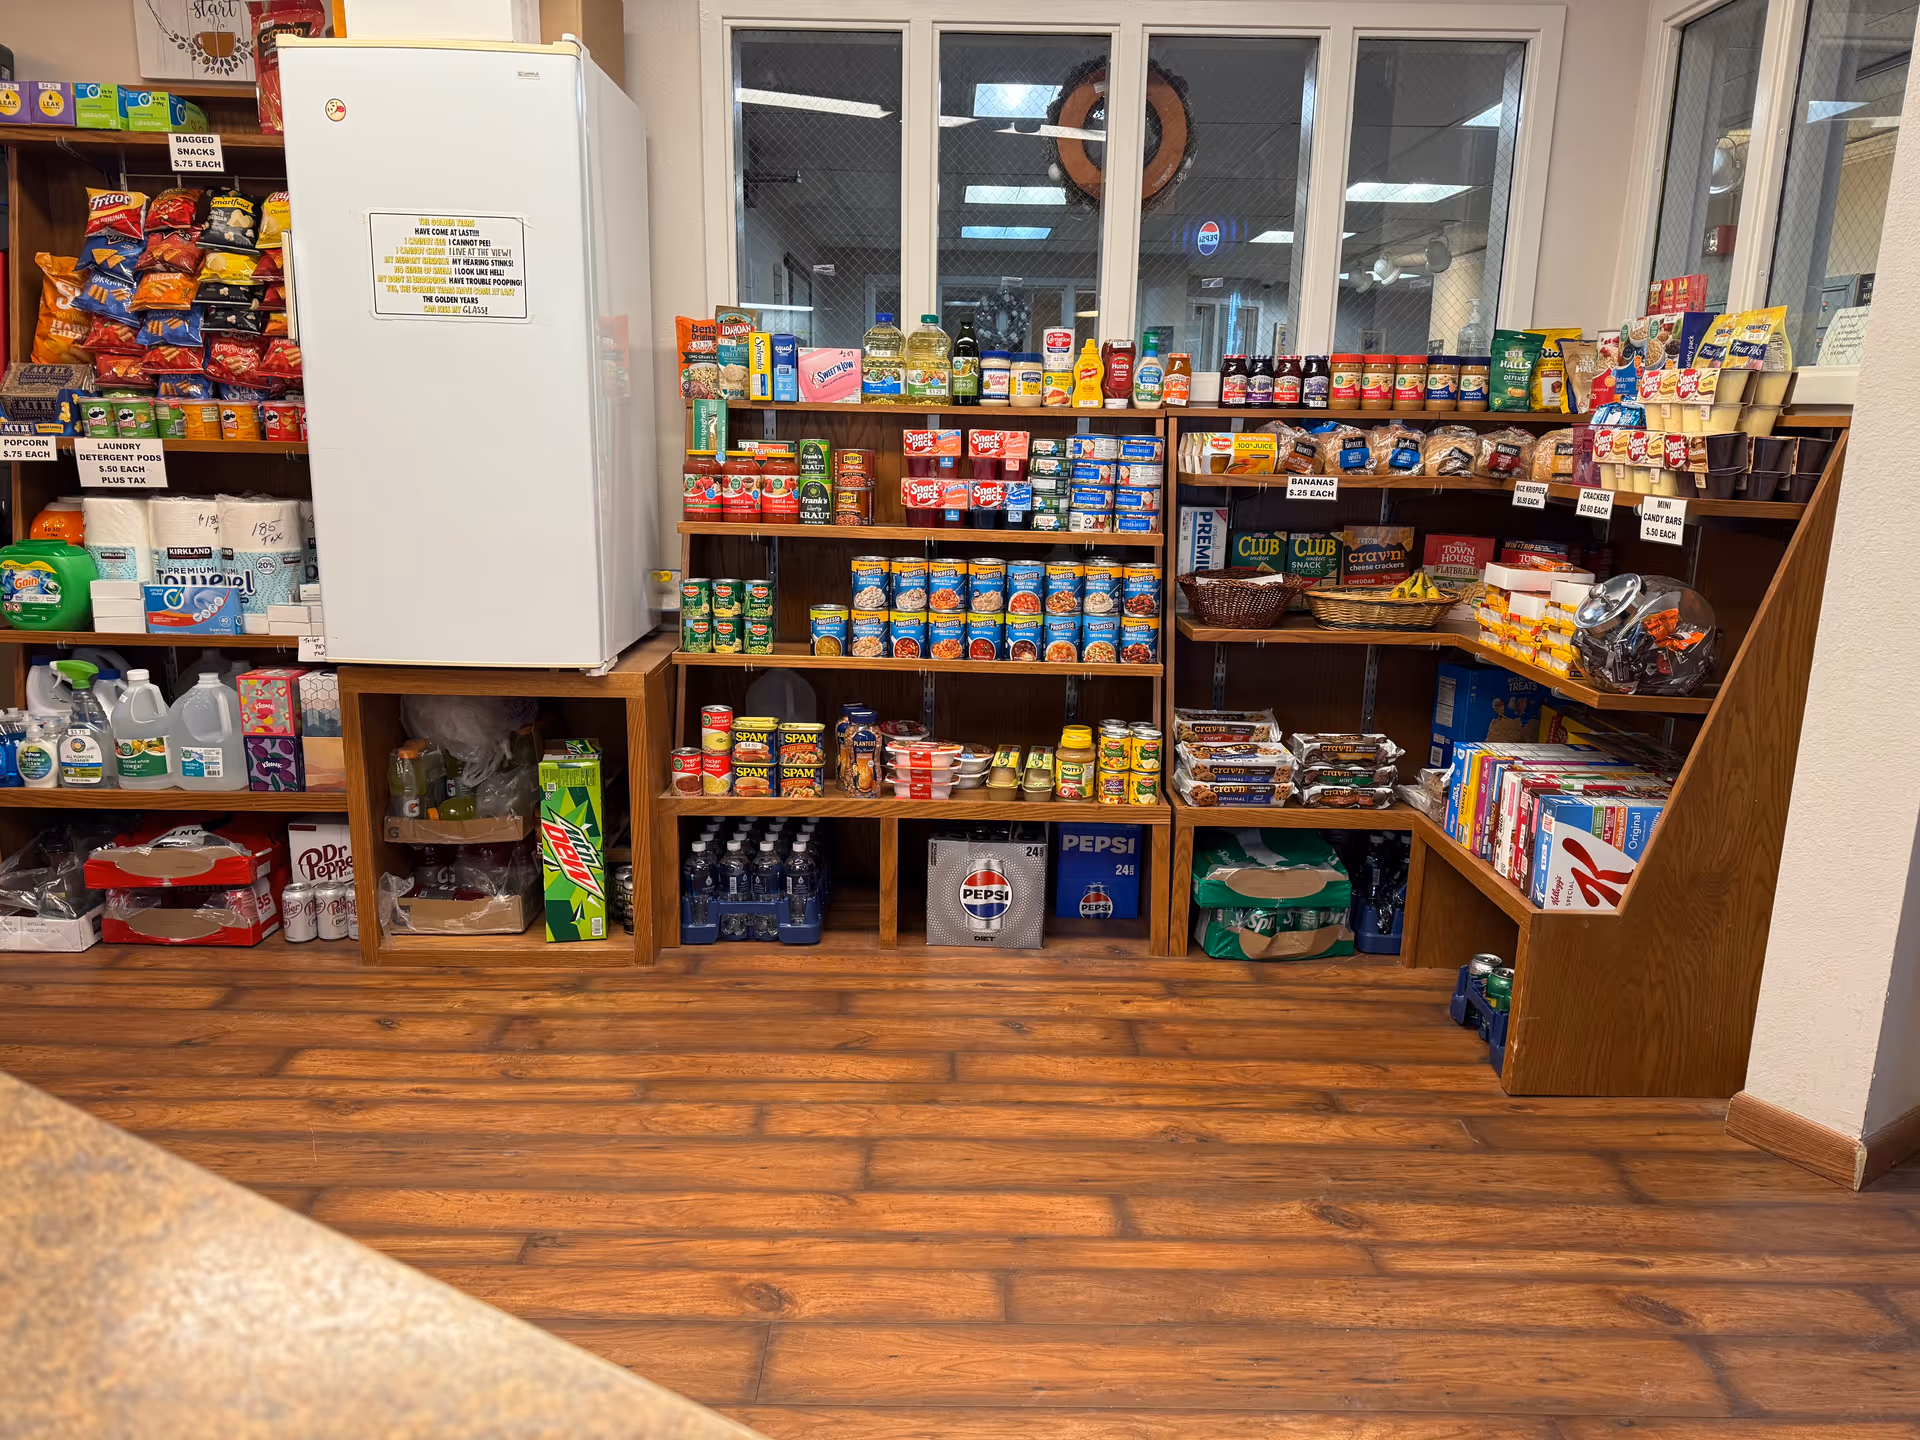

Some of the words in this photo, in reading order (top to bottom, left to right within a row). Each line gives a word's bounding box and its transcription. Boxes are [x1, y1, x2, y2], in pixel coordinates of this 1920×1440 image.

[191, 0, 237, 18] start
[175, 136, 214, 144] BAGGED
[177, 148, 216, 156] SNACKS
[195, 160, 222, 168] EACH
[90, 193, 132, 210] Fritos
[210, 197, 250, 210] Smartfood
[100, 212, 127, 223] ORIGINAL
[452, 248, 466, 256] LIVE
[467, 248, 476, 256] AT
[477, 248, 489, 256] THE
[491, 249, 512, 257] VIEW!
[462, 306, 488, 315] GLASS!
[692, 323, 716, 334] Ben's
[722, 325, 751, 337] IDAHOAN
[1046, 336, 1072, 344] Carnation
[755, 336, 765, 371] Splenda
[775, 344, 793, 353] equal
[1499, 360, 1532, 369] HALLS
[1641, 374, 1661, 388] Snack
[1678, 373, 1698, 387] Snack
[1643, 384, 1660, 396] pack
[1681, 383, 1698, 395] pack
[700, 406, 708, 434] spaghetti
[4, 439, 49, 447] POPCORN
[906, 431, 934, 444] Snack
[972, 431, 1001, 444] Snack
[97, 442, 141, 450] LAUNDRY
[912, 439, 934, 450] pack
[978, 440, 1000, 452] pack
[1665, 437, 1686, 452] Snack
[3, 450, 22, 458] $.75
[25, 450, 51, 458] EACH
[79, 454, 134, 462] DETERGENT
[136, 454, 162, 462] PODS
[802, 453, 822, 461] Frank's
[843, 454, 862, 462] BUSH'S
[1669, 448, 1687, 461] pack
[98, 465, 118, 473] $.50
[120, 465, 146, 473] EACH
[101, 476, 126, 484] PLUS
[128, 476, 147, 484] TAX
[1291, 478, 1335, 487] BANANAS
[910, 482, 939, 495] Snack
[974, 485, 1003, 498] Snack
[1289, 489, 1307, 497] $.25
[1309, 490, 1334, 498] EACH
[1516, 485, 1526, 493] RICE
[1526, 486, 1546, 495] KRISPIES
[802, 496, 828, 505] Frank's
[916, 491, 940, 502] pack
[980, 493, 1002, 505] pack
[1527, 498, 1540, 506] EACH
[1583, 491, 1610, 502] CRACKERS
[1580, 504, 1593, 513] $0.60
[1593, 506, 1609, 516] EACH
[1657, 500, 1672, 510] MINI
[800, 512, 831, 520] KRAUT
[1643, 513, 1664, 524] CANDY
[1665, 516, 1682, 526] BARS
[1646, 527, 1659, 537] $.50
[1659, 529, 1677, 540] EACH
[1238, 535, 1280, 556] CLUB
[1295, 535, 1337, 556] CLUB
[1443, 545, 1475, 556] TOWN
[169, 548, 211, 556] KIRKLAND
[1348, 550, 1402, 563] crav'n
[1441, 553, 1476, 565] HOUSE
[857, 568, 882, 577] PROGRESSO
[1291, 568, 1322, 576] STACKS
[1349, 564, 1373, 572] cheese
[1374, 562, 1405, 571] crackers
[1436, 565, 1479, 577] FLATBREAD
[901, 569, 925, 578] PROGRESSO
[932, 569, 957, 578] PROGRESSO
[1013, 573, 1038, 581] PROGRESSO
[14, 575, 39, 590] Gain
[1508, 680, 1537, 691] TREATS
[1194, 725, 1227, 734] crav'n
[736, 732, 767, 743] SPAM
[785, 733, 817, 744] SPAM
[1321, 744, 1352, 753] crav'n
[736, 767, 768, 777] SPAM
[783, 768, 815, 778] SPAM
[1061, 765, 1083, 774] MOTT'S
[1212, 766, 1245, 774] crav'n
[1322, 769, 1350, 777] crav'n
[1213, 784, 1246, 793] crav'n
[1628, 812, 1641, 850] Original
[1616, 827, 1625, 847] Simply
[560, 819, 603, 870] Mtn
[1063, 834, 1136, 854] PEPSI
[322, 843, 348, 863] Dr
[1026, 846, 1039, 857] 24
[1115, 864, 1128, 875] 24
[963, 889, 1009, 901] PEPSI
[1551, 874, 1564, 906] Kellogg's
[1566, 880, 1575, 907] SPECIAL
[256, 894, 272, 911] 35
[1081, 904, 1111, 912] PEPSI
